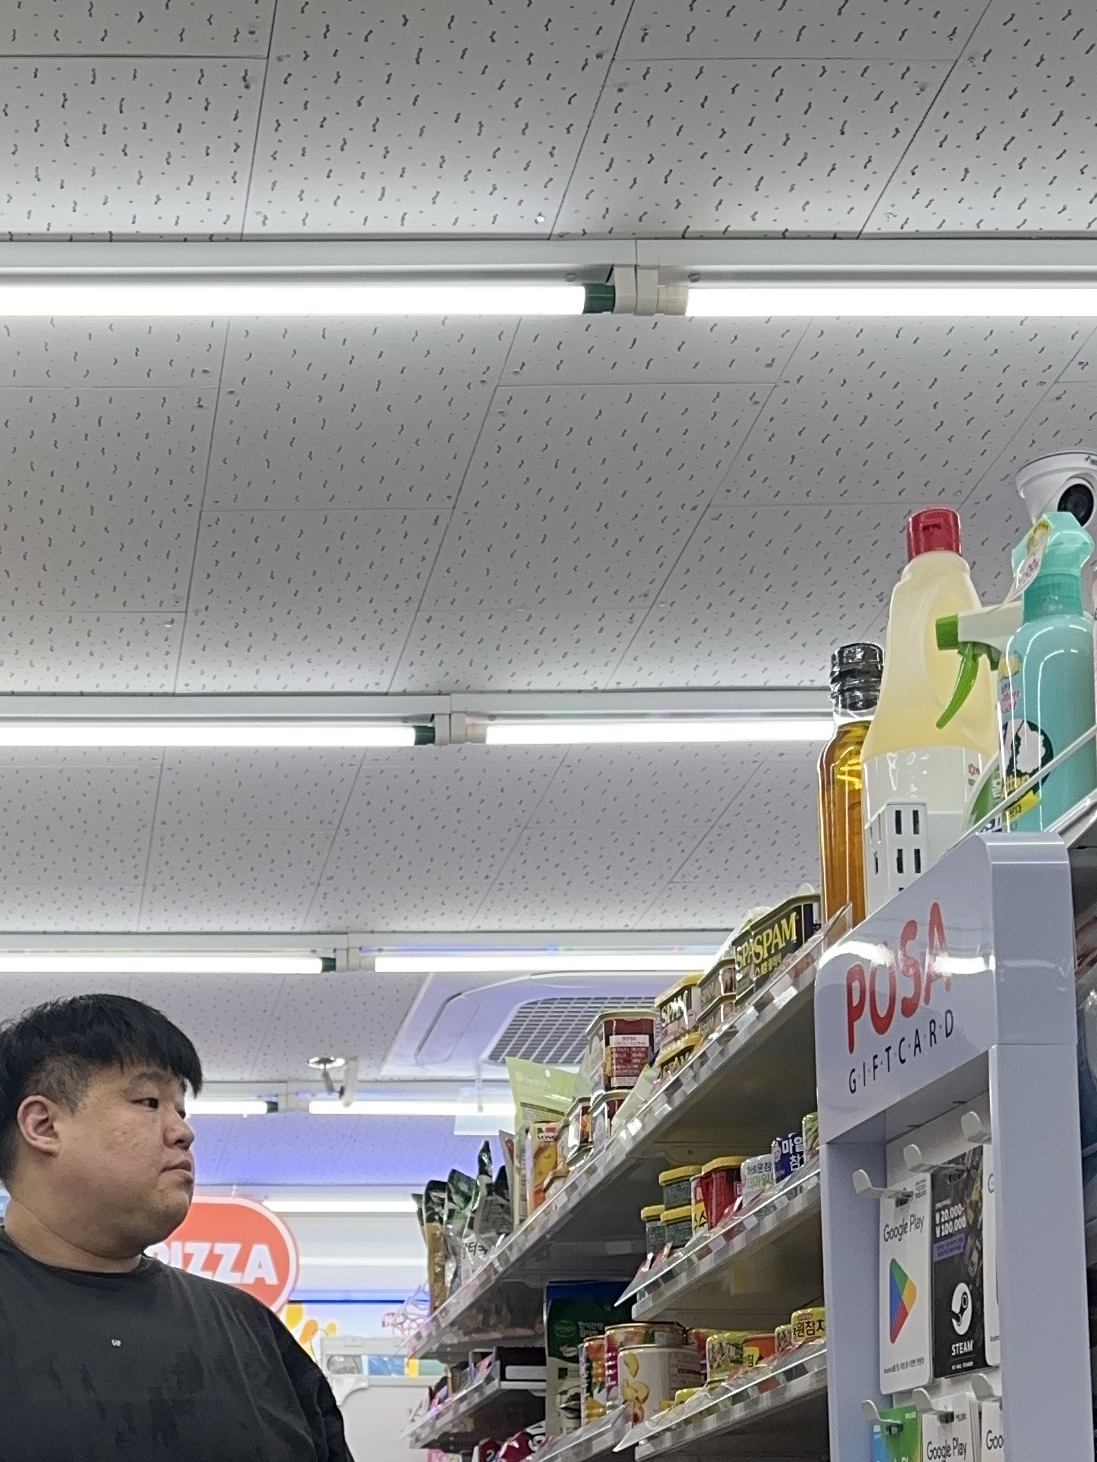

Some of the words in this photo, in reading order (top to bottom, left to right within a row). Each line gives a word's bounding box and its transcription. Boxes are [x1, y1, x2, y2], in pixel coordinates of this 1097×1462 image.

[753, 911, 798, 964] SPAM
[846, 901, 953, 1054] POSA
[883, 1219, 909, 1243] Google
[909, 1213, 925, 1233] Play
[951, 1339, 974, 1356] STEAM
[952, 1437, 967, 1461] Play
[986, 1429, 1004, 1451] Goo
